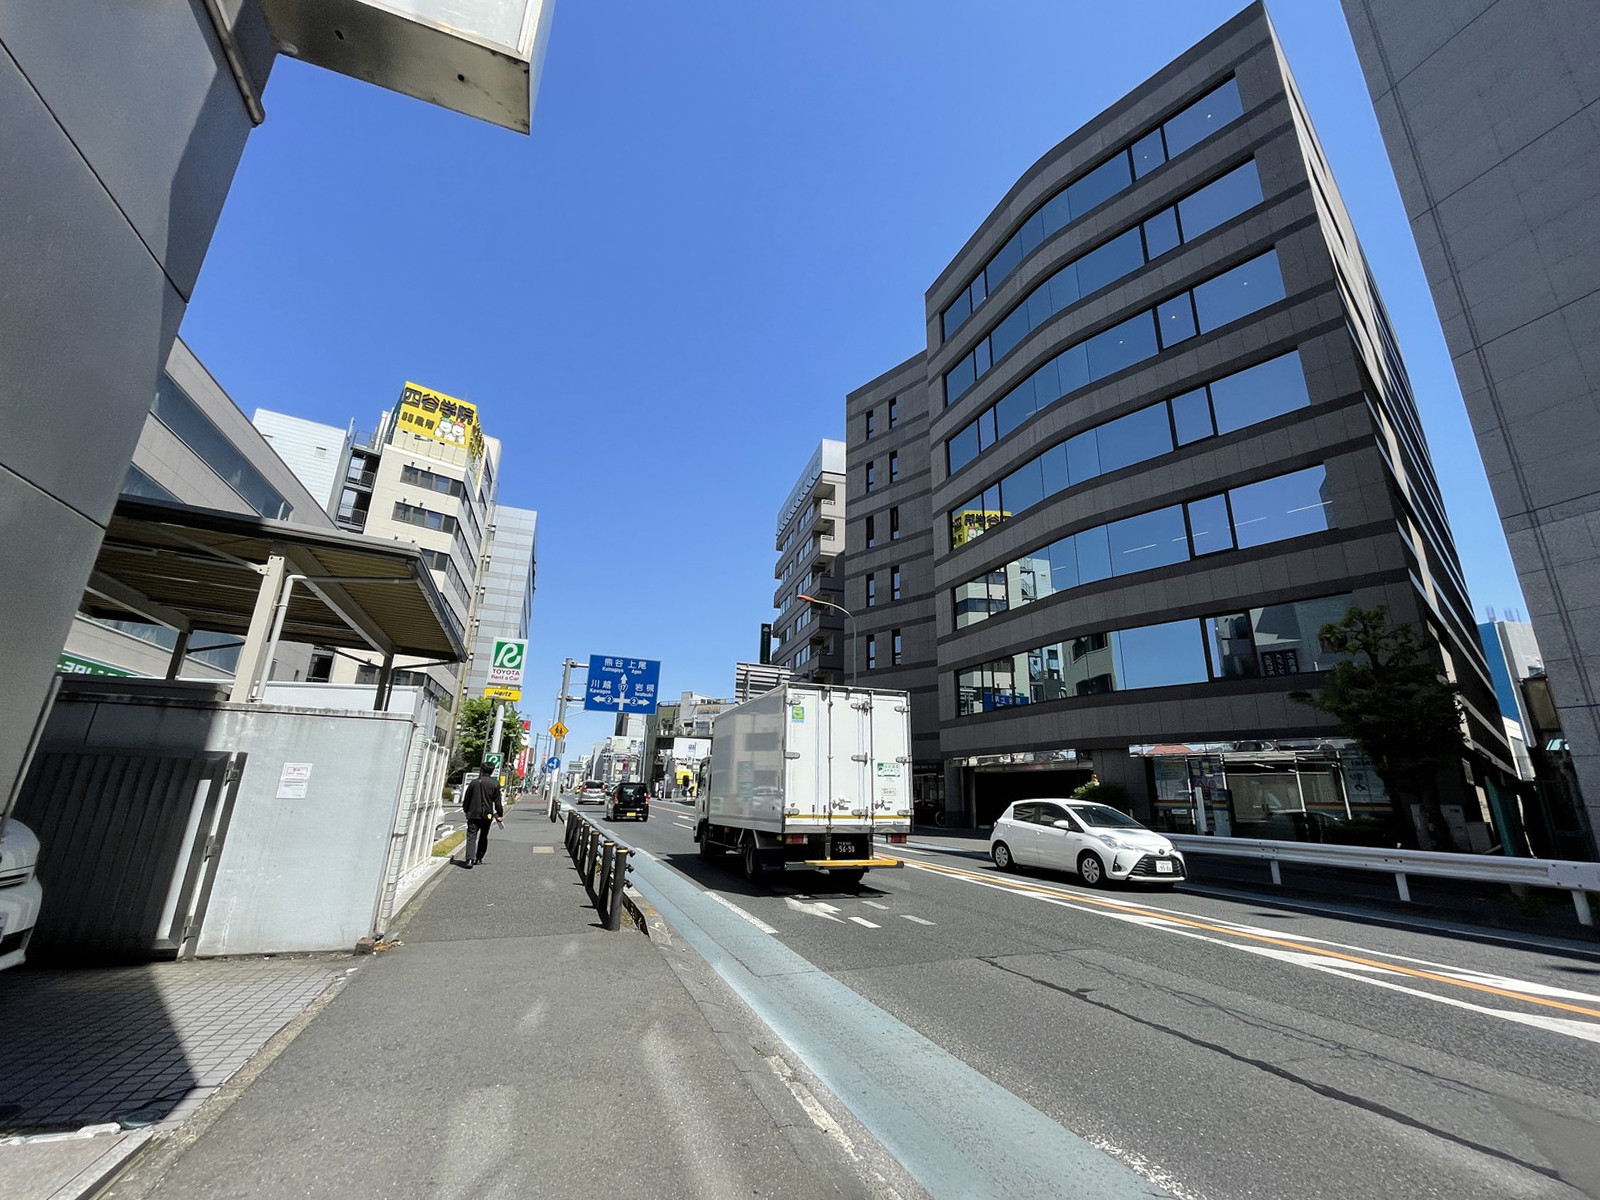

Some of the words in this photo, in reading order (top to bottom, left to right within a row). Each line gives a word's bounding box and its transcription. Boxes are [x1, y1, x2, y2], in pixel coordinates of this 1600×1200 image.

[403, 387, 475, 426] 四谷学院
[604, 658, 623, 668] 熊谷
[628, 660, 647, 670] 上尾
[492, 668, 520, 676] TOYOTA
[591, 679, 612, 690] 川越
[635, 683, 655, 693] 岩槻
